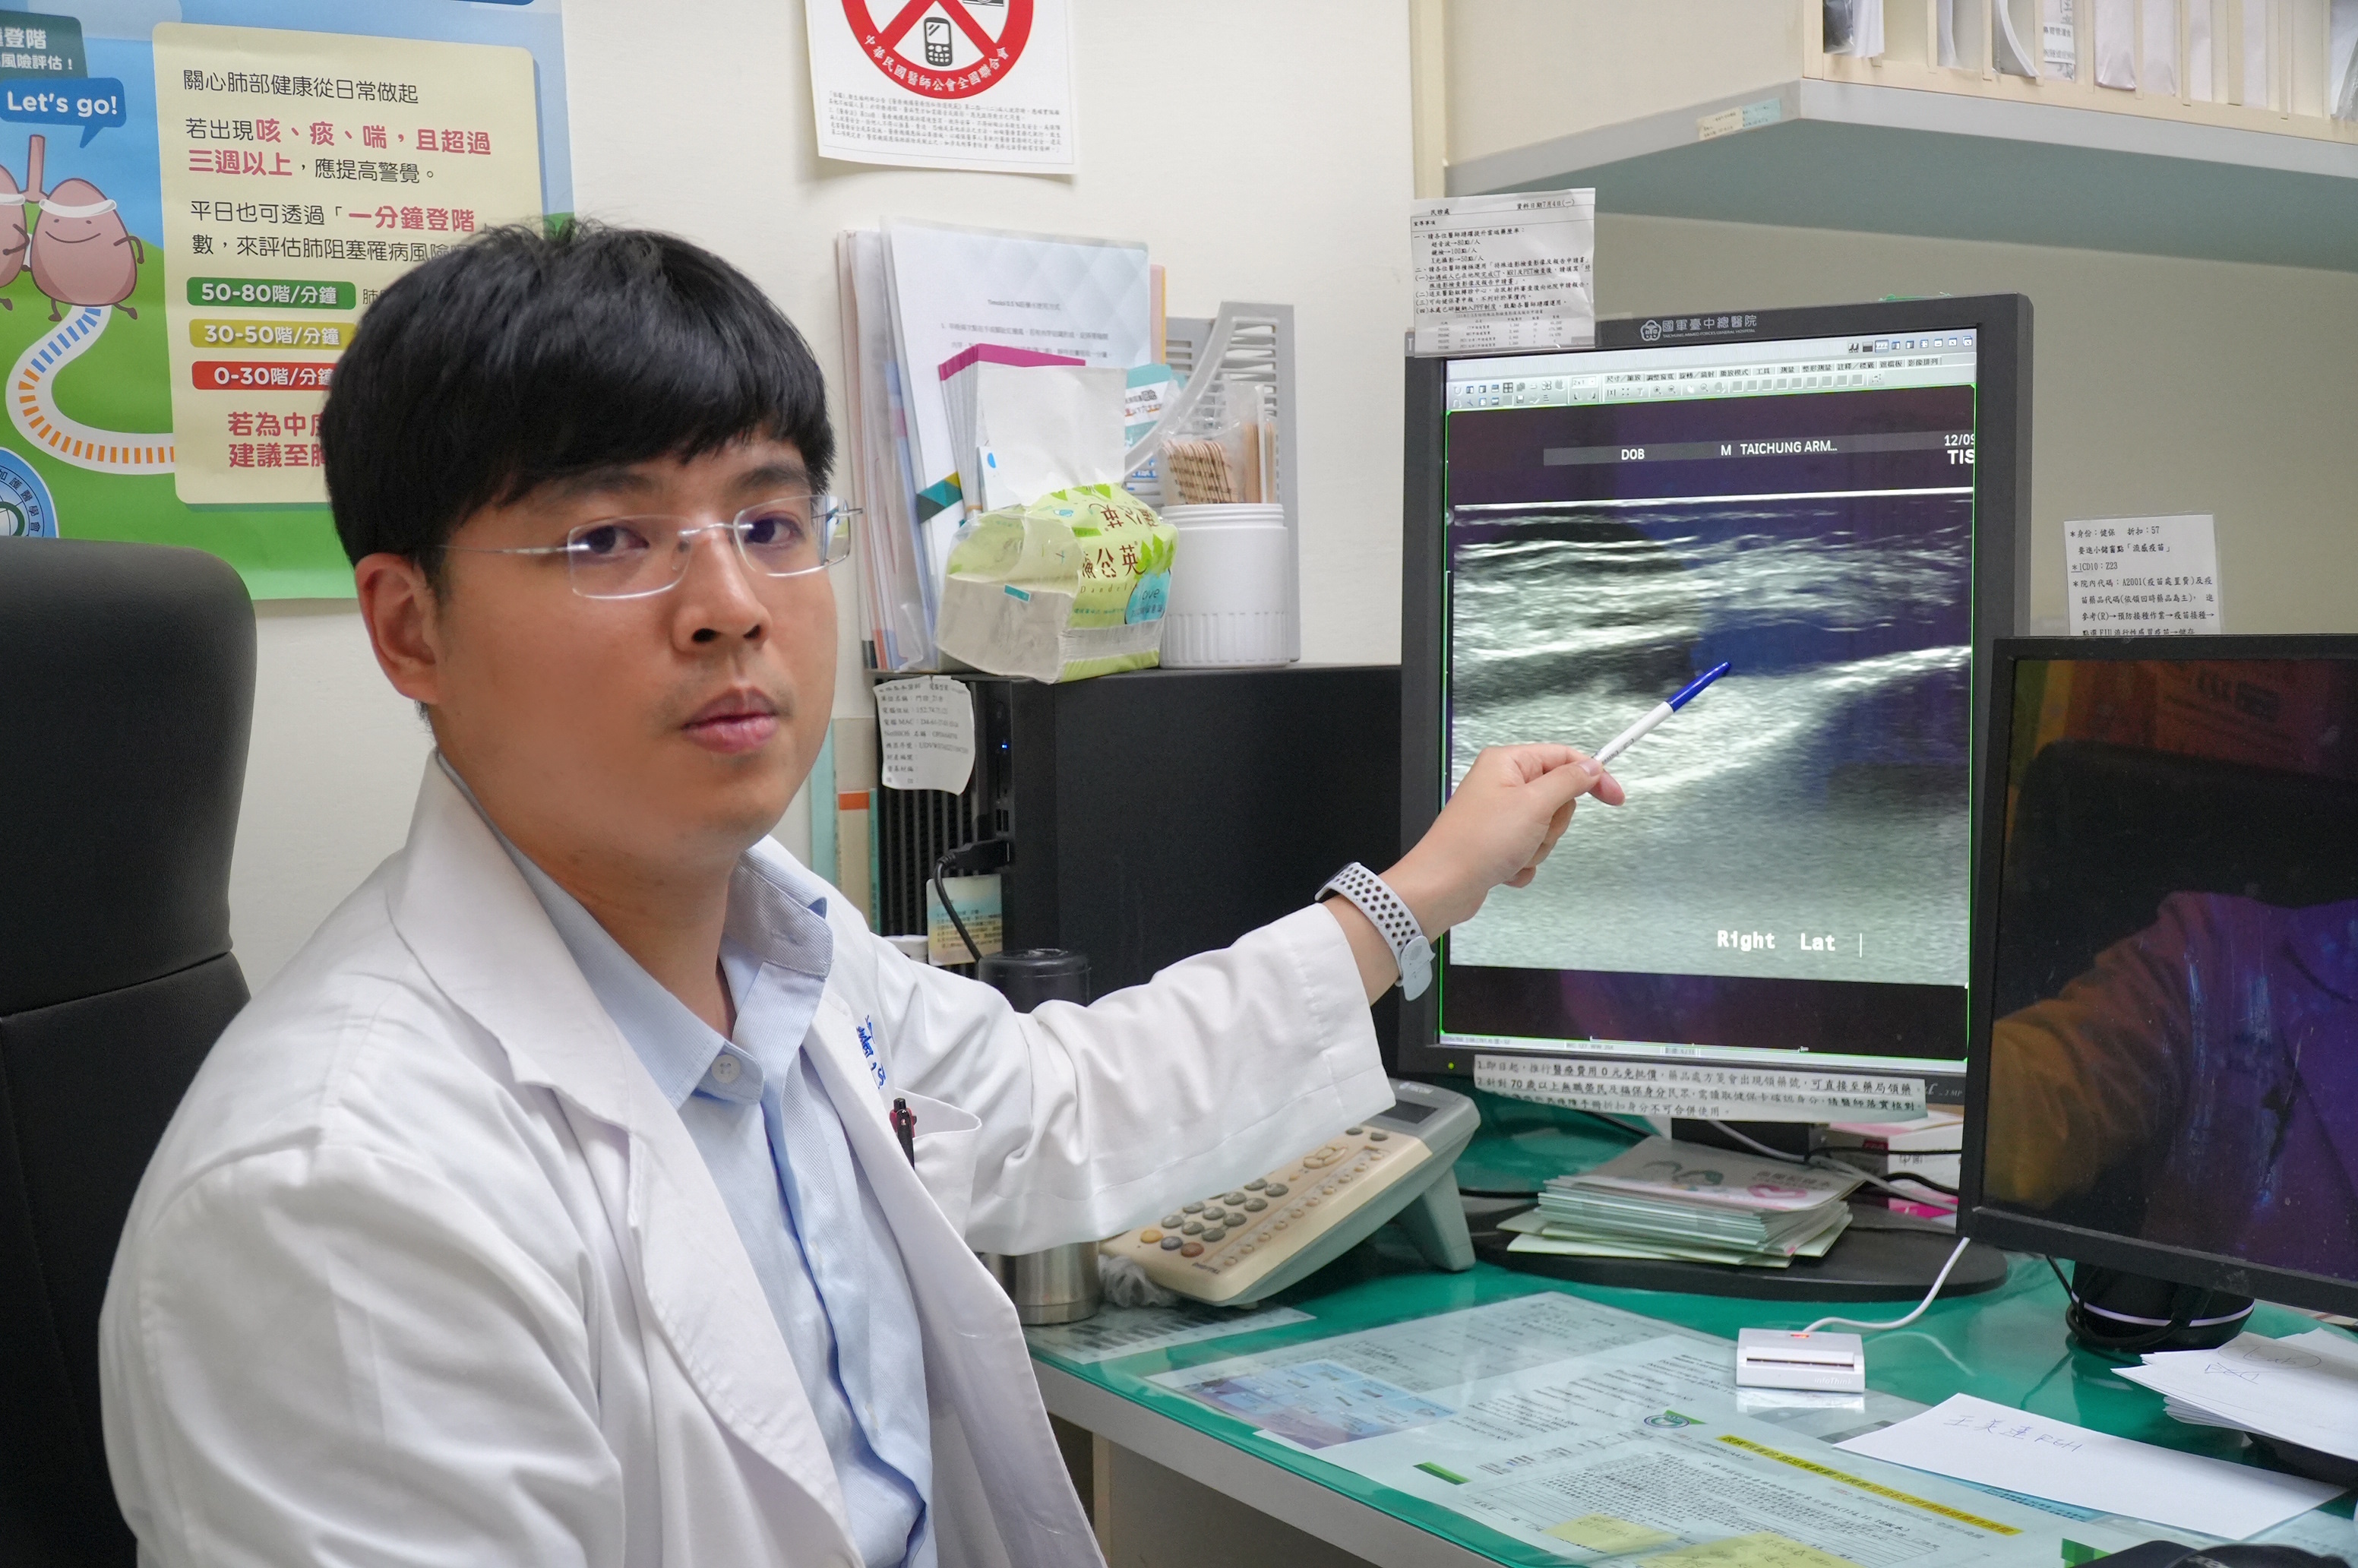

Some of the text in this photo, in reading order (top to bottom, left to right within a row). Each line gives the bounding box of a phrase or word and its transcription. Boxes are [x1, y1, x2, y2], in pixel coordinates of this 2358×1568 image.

[0, 27, 46, 49] 登階
[864, 34, 1010, 91] 中華民國醫師公會全國聯合會
[183, 69, 419, 103] 關心肺部健康從日常做起
[8, 90, 118, 118] Let's go!
[185, 117, 492, 156] 若出現咳、痰、喘，且超過
[188, 149, 435, 183] 三週以上，應提高警覺。
[192, 233, 466, 263] 數，來評估肺阻塞罹病風險
[201, 283, 337, 305] 50-80階/分鐘
[362, 288, 383, 305] 肺
[1662, 315, 1757, 332] 國軍臺中總醫院
[204, 324, 340, 346] 30-50階/分鐘
[1621, 448, 1645, 460] DOB
[1721, 445, 1732, 456] M
[1740, 441, 1801, 455] TAICHUNG
[1947, 449, 1974, 464] TIS
[1717, 930, 1836, 951] Right Lat
